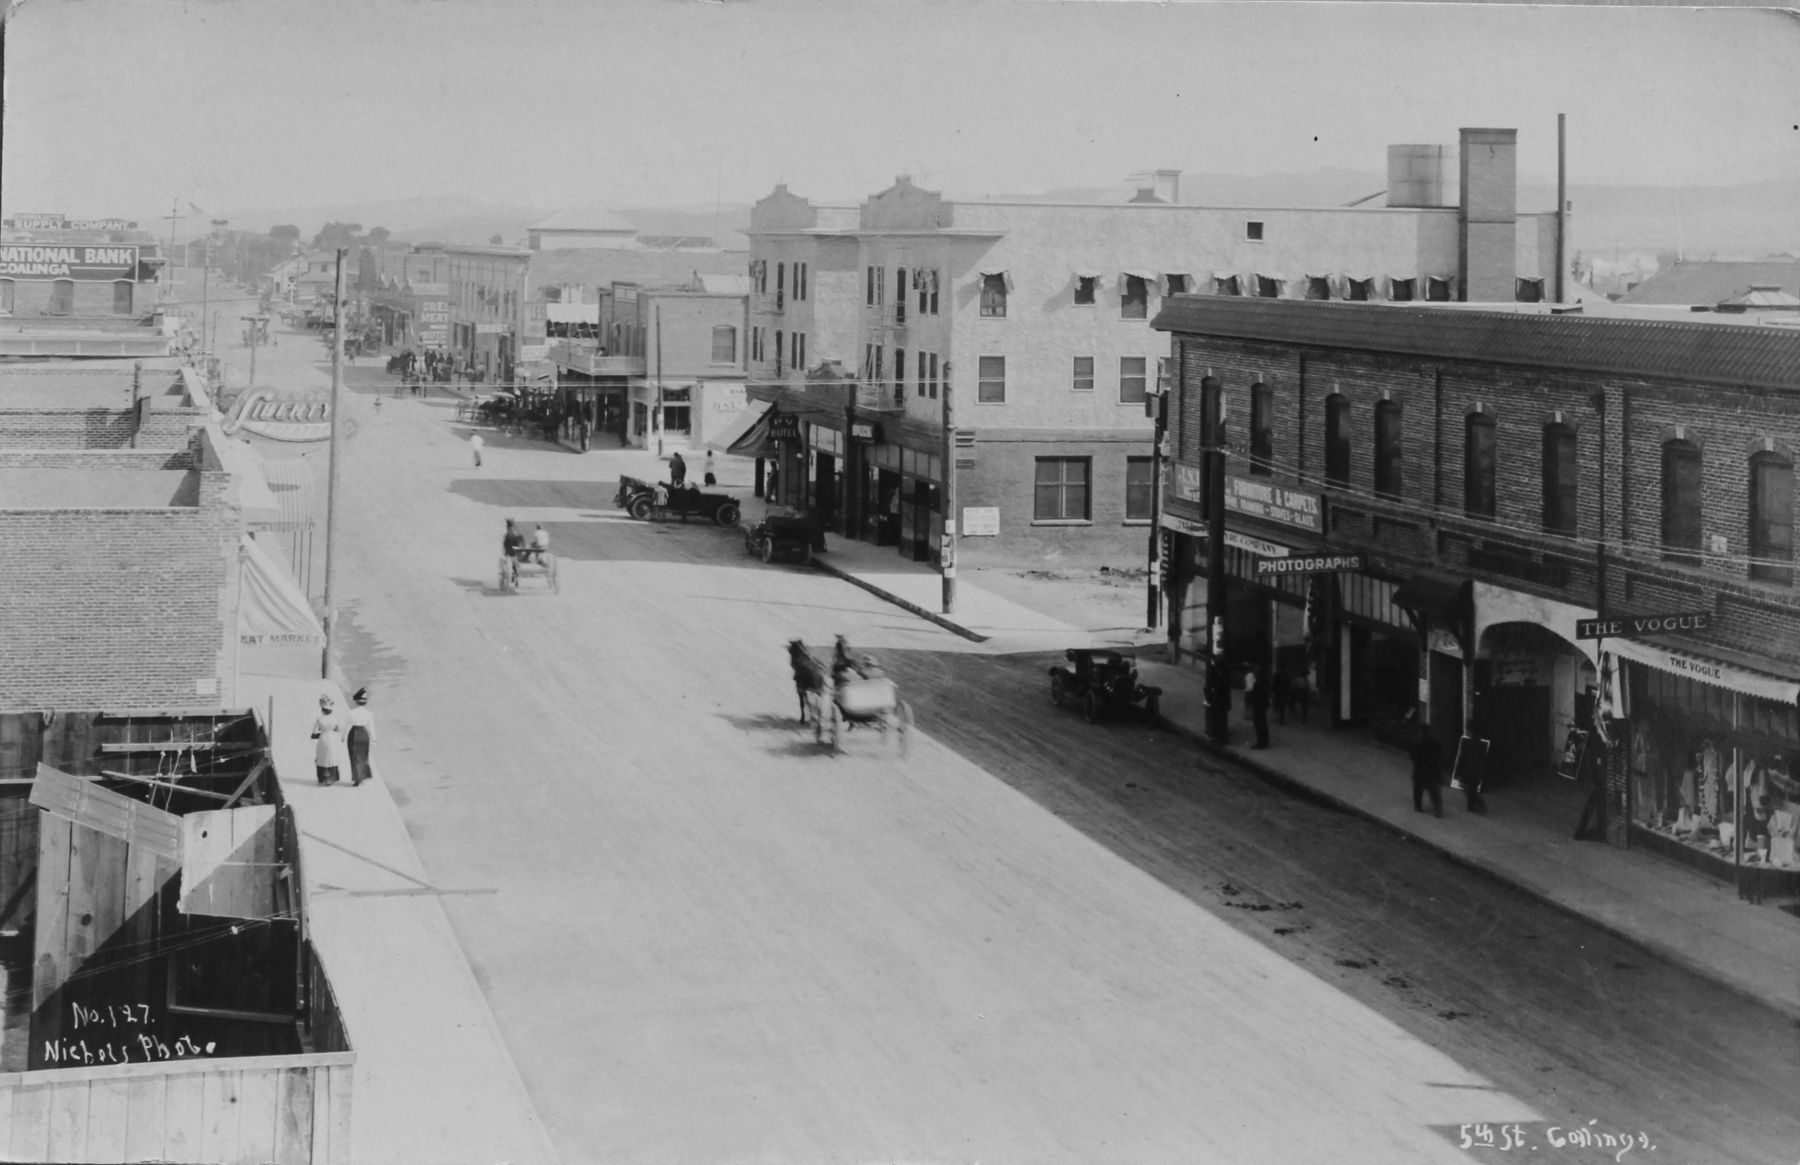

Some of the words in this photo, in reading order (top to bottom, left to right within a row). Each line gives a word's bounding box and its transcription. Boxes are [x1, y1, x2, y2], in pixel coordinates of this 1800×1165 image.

[14, 219, 64, 229] SUPPLY
[70, 219, 129, 230] COMPANY
[1, 247, 80, 263] NATIONAL
[84, 248, 133, 264] BANK
[0, 263, 70, 275] COALINGA
[1283, 491, 1319, 515] CARPETS
[1257, 555, 1361, 574] PHOTOGRAPHS
[1582, 621, 1623, 636] THE
[1633, 615, 1708, 632] VOGUE
[1669, 656, 1688, 670] THE
[1689, 662, 1722, 680] VOGUE
